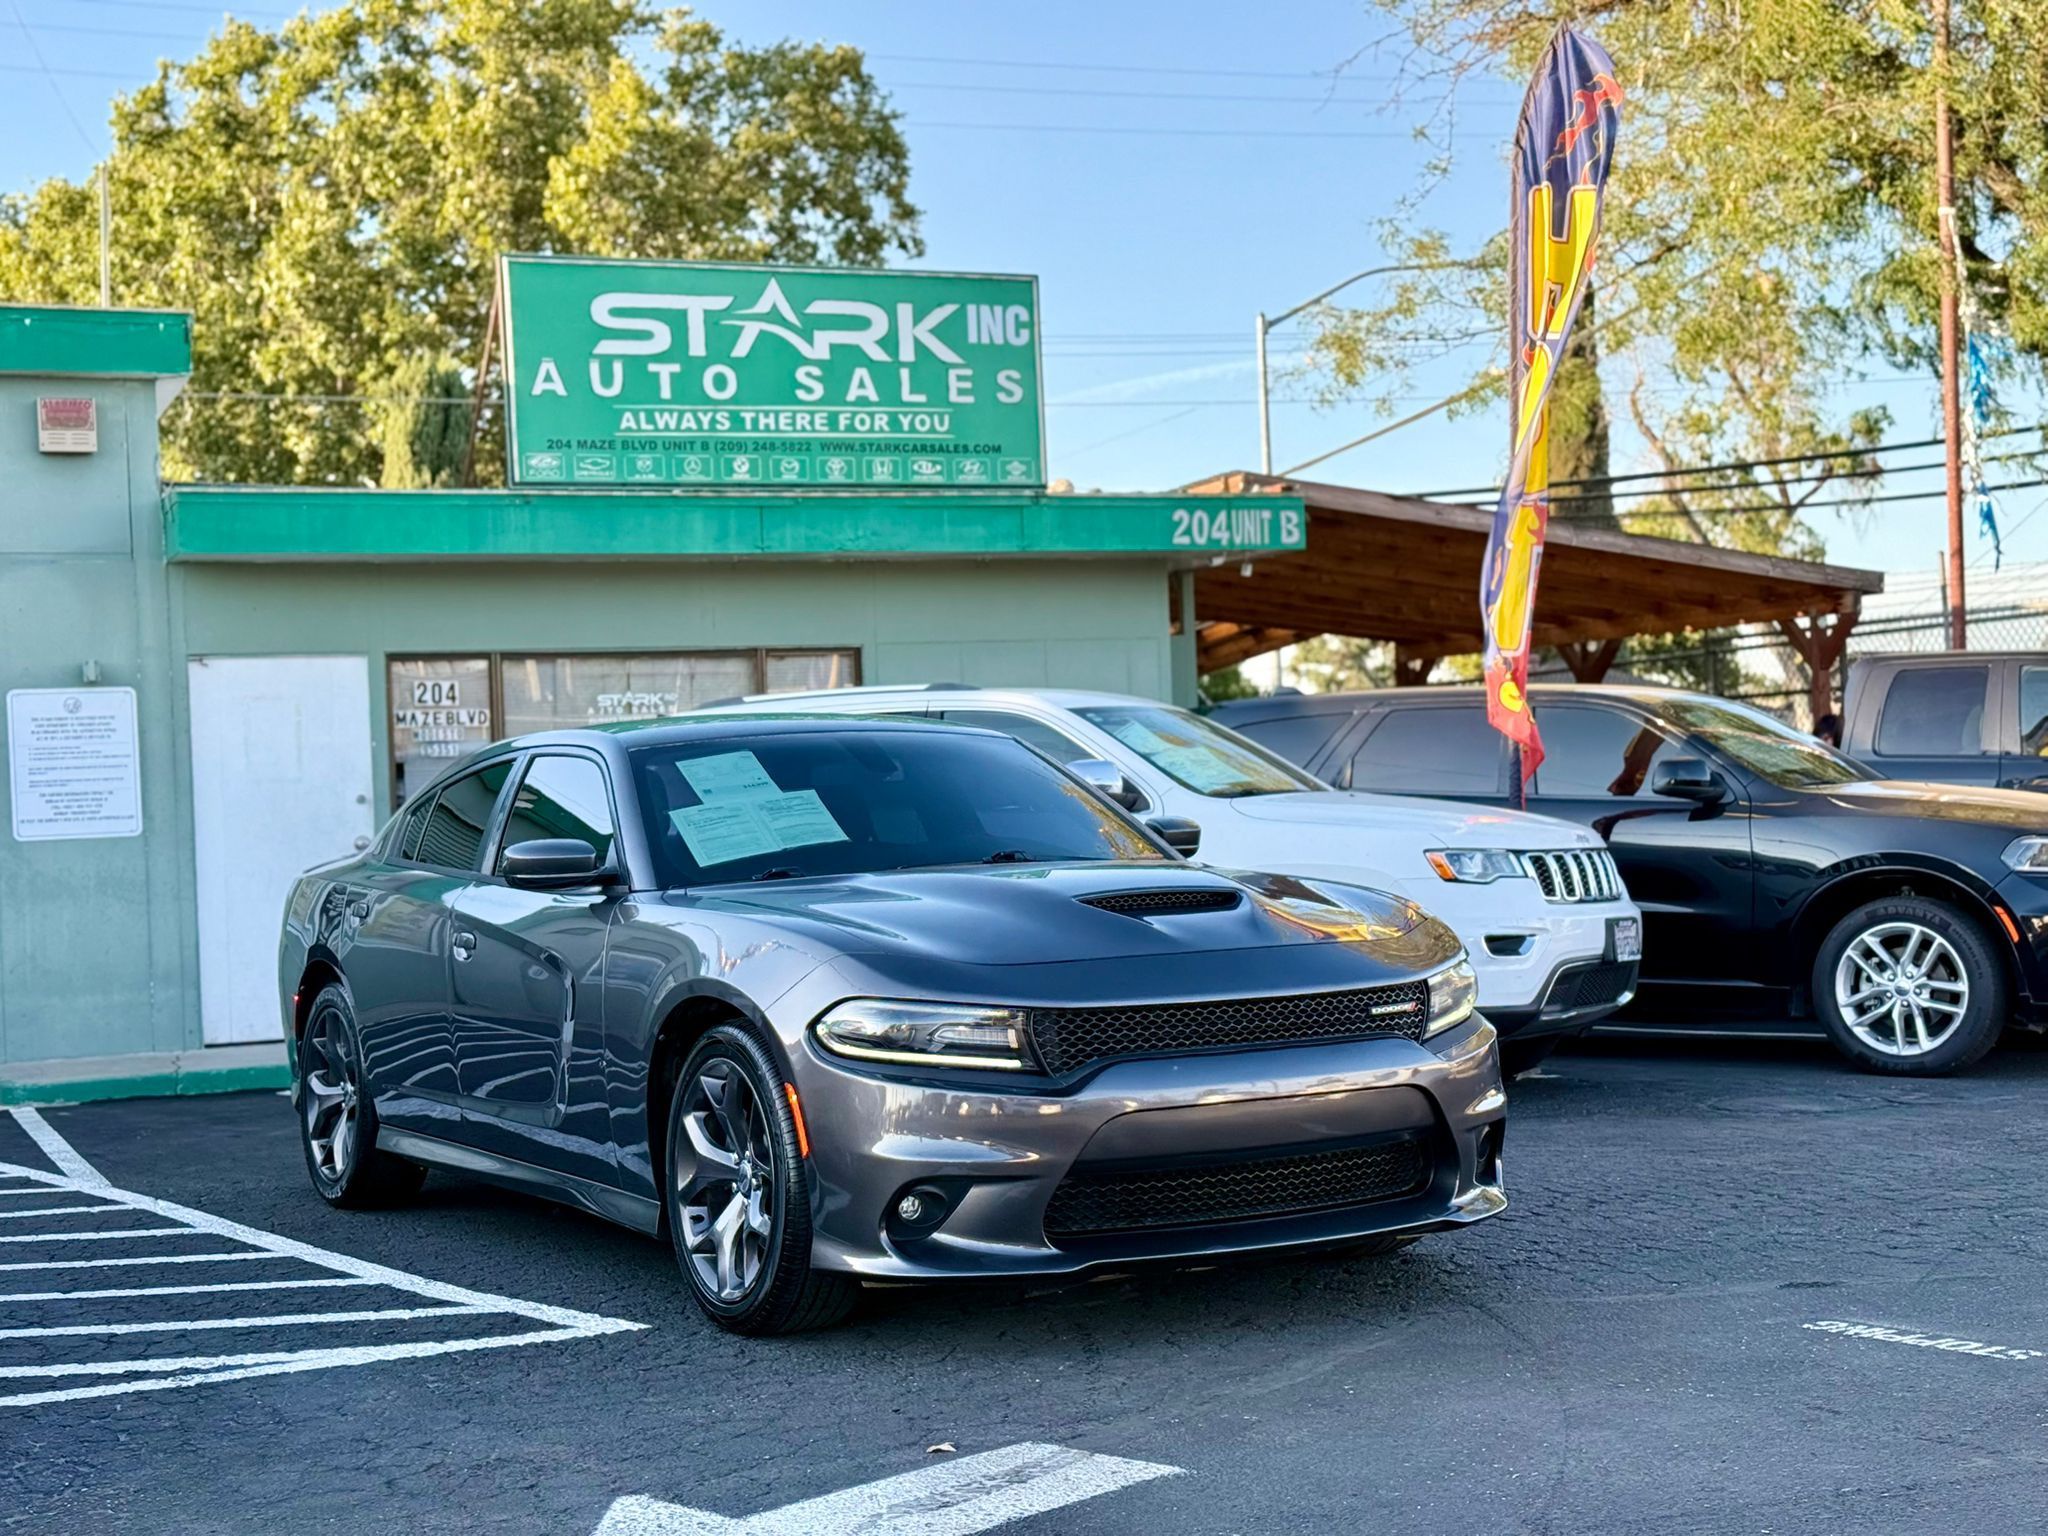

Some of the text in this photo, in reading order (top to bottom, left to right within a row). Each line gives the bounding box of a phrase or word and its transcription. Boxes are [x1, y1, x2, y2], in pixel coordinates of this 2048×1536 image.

[589, 276, 1030, 364] STARK INC
[530, 357, 1024, 404] AUTO SALES
[619, 410, 950, 432] ALWAYS THERE FOR YOU
[546, 438, 572, 450] 204
[576, 439, 617, 451] MAZE
[620, 439, 659, 451] BLVD
[662, 440, 698, 451] UNIT
[701, 440, 710, 452] B
[714, 440, 749, 454] (209)
[819, 441, 1003, 455] WWW.STARKCARSALES.COM
[1171, 508, 1301, 546] 204 UNIT B
[417, 682, 457, 704] 204
[597, 691, 664, 707] STARK
